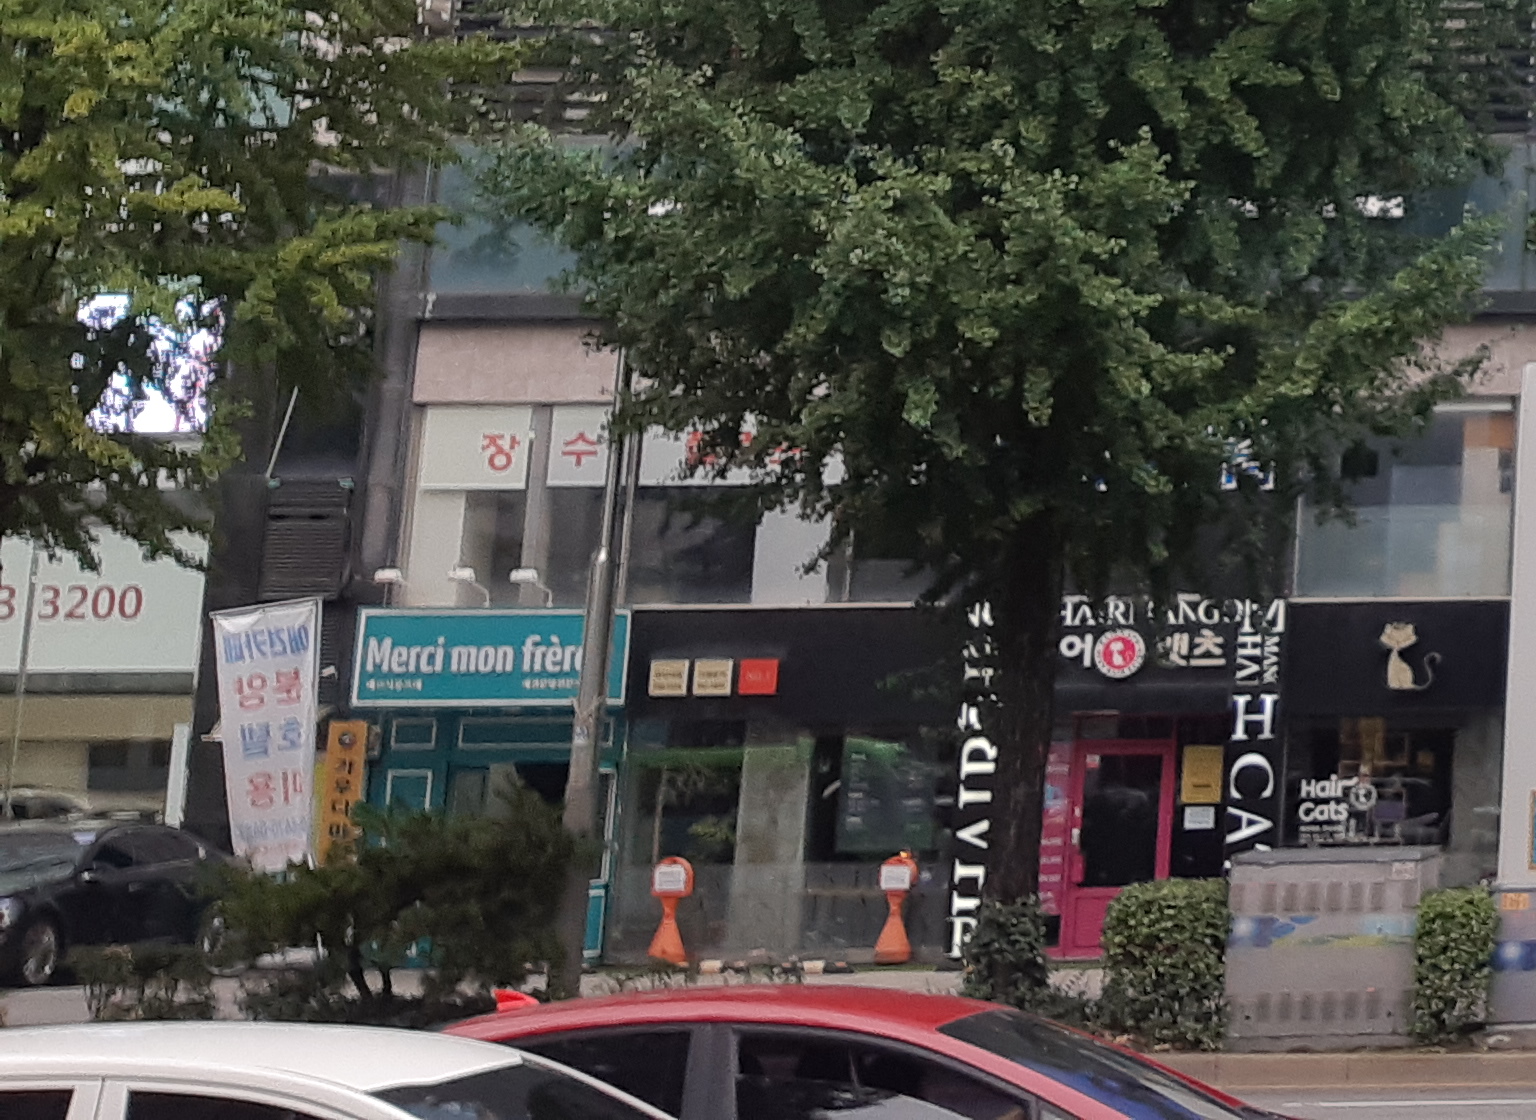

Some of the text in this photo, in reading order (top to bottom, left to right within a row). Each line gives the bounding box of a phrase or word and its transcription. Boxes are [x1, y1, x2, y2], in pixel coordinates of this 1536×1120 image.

[38, 584, 143, 620] 3200
[366, 635, 446, 675] Merci
[450, 643, 514, 674] mon
[1300, 773, 1360, 799] Hair
[1298, 799, 1349, 822] Cats
